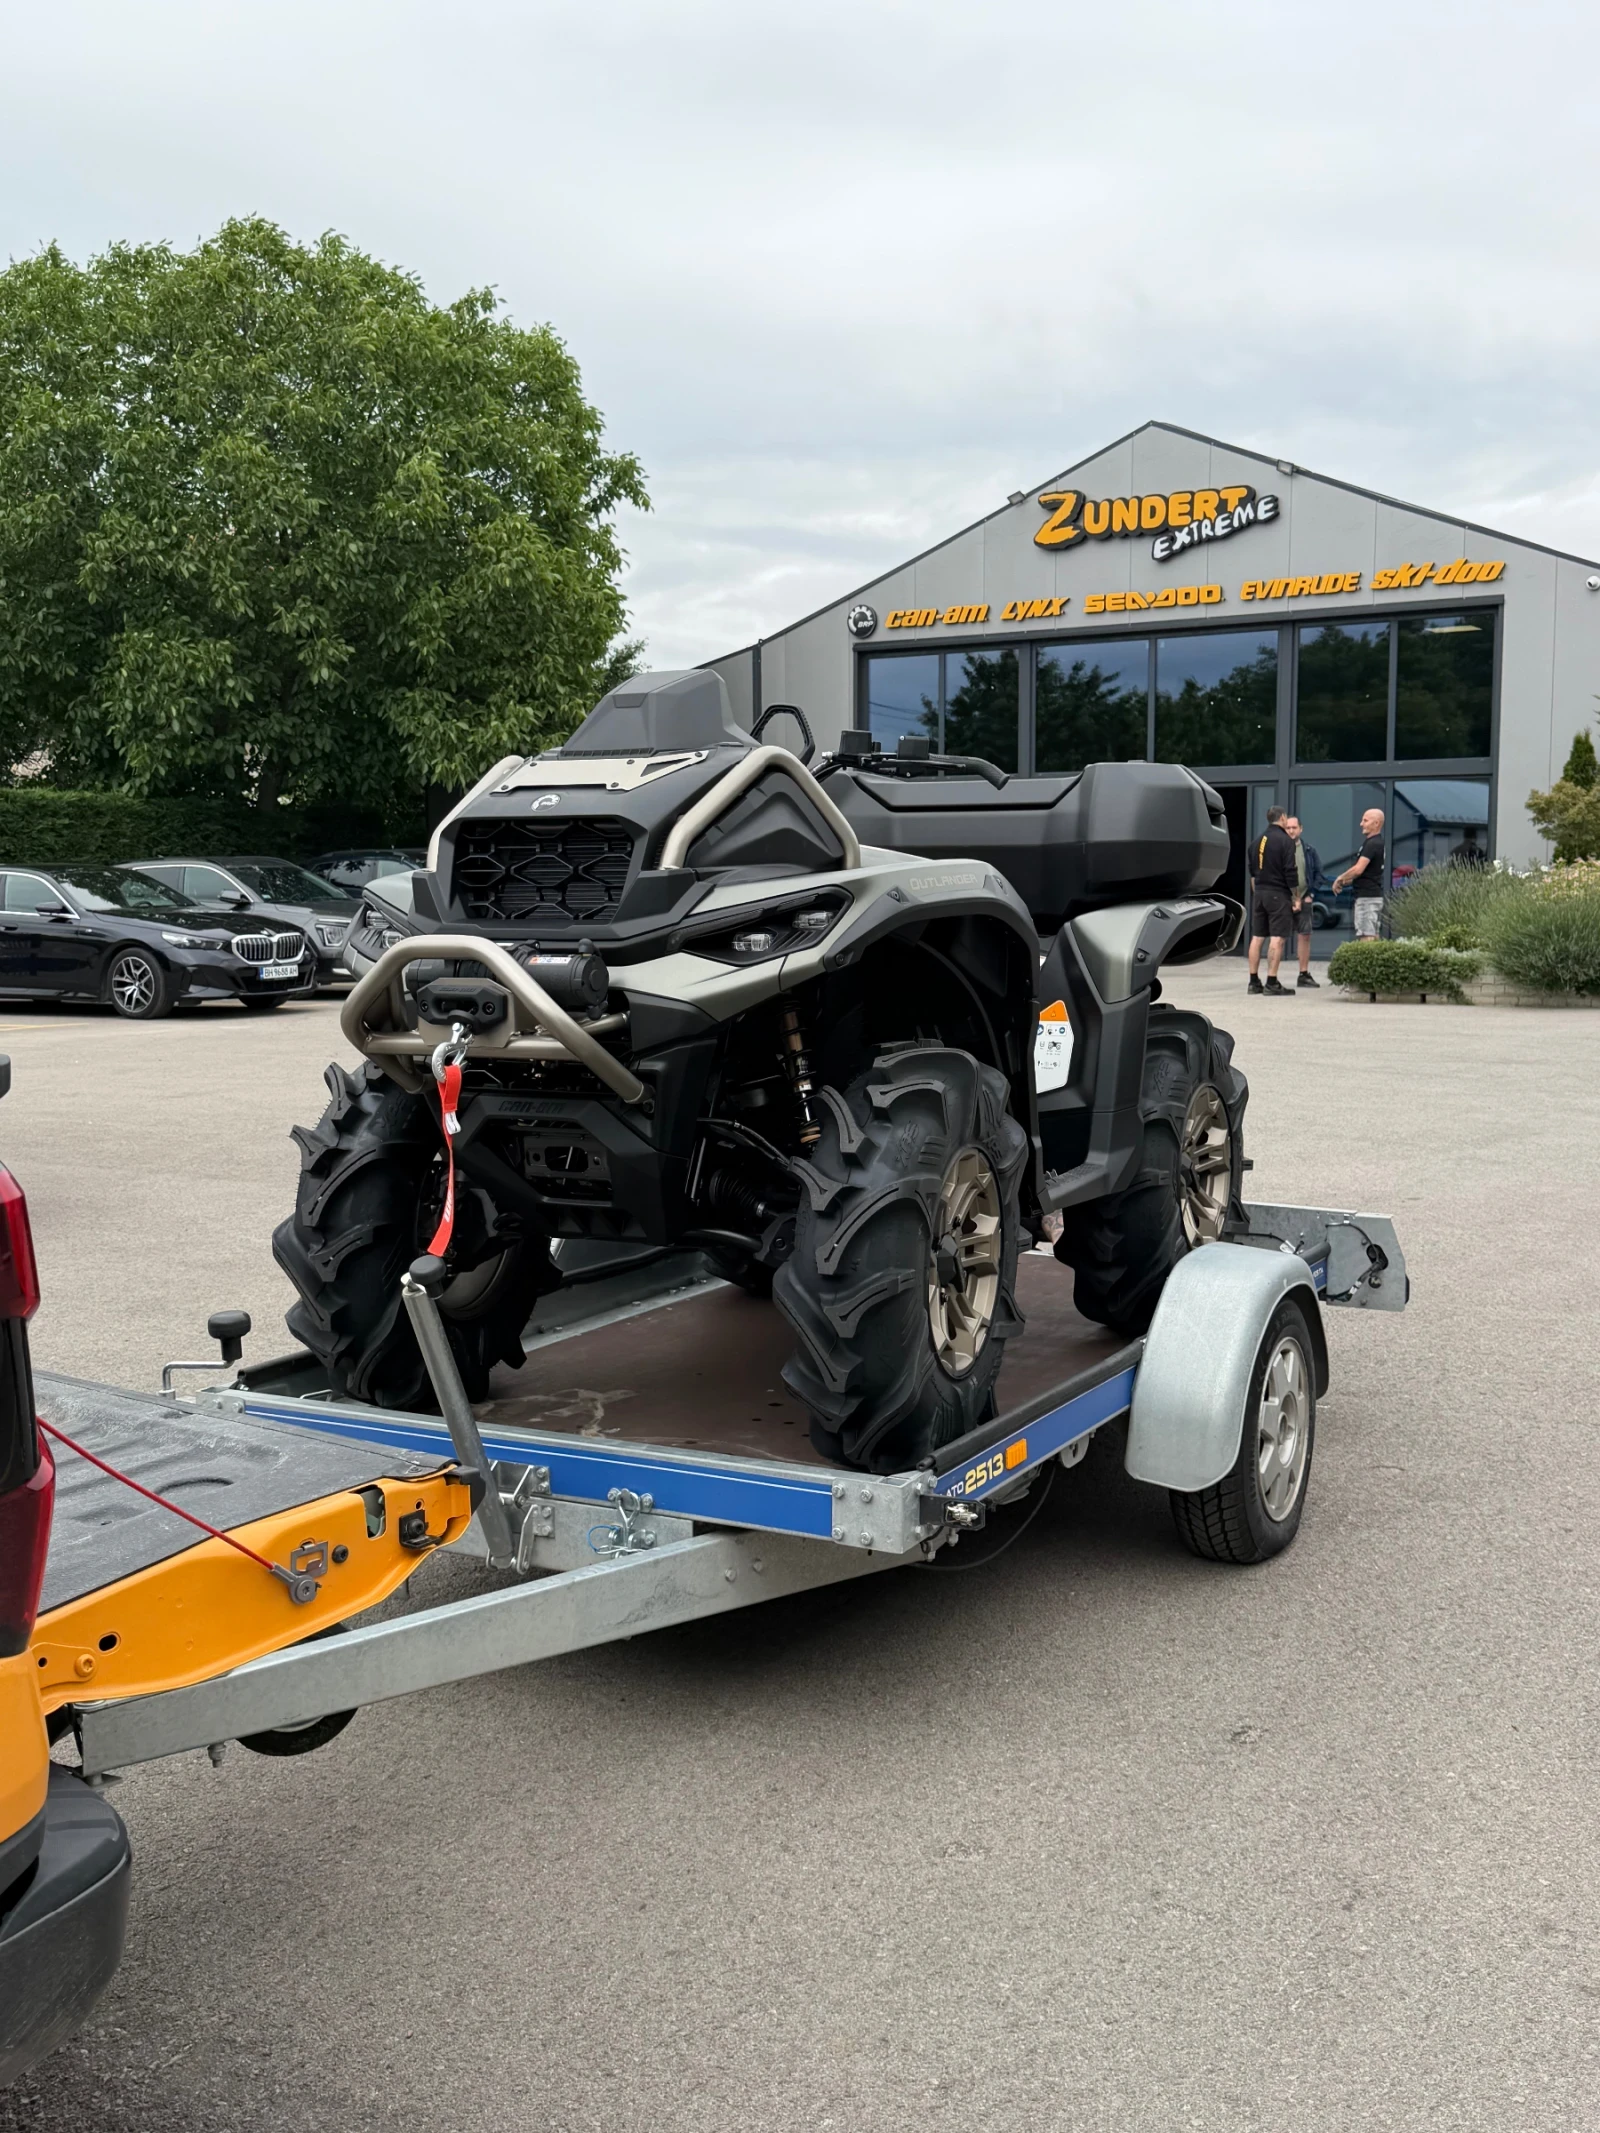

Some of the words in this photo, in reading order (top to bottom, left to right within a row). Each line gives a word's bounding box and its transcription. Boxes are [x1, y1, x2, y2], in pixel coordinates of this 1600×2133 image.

[1034, 487, 1248, 545] ZUNDERT
[1153, 496, 1277, 559] EXTREME
[1240, 572, 1359, 600] EVINRUDE
[909, 873, 978, 890] OUTLANDER
[965, 1452, 1004, 1495] 2513
